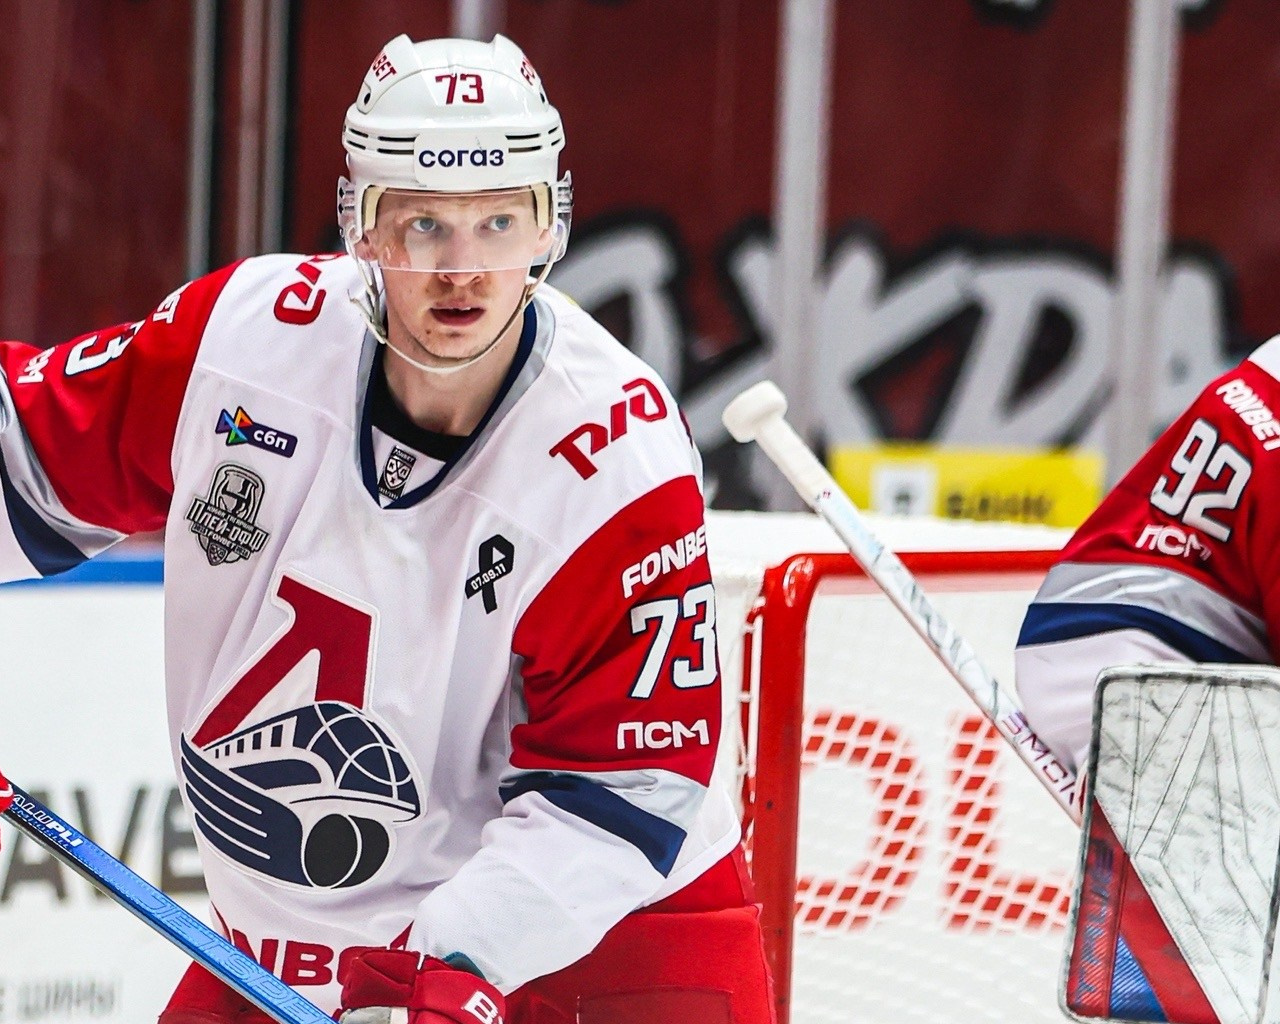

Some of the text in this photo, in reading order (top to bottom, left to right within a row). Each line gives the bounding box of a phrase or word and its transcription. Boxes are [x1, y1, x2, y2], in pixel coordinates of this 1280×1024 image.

[435, 73, 485, 105] 73
[418, 149, 504, 168] согаз
[17, 347, 56, 384] СМ
[65, 320, 146, 376] 3
[253, 430, 288, 450] сбп
[1150, 418, 1252, 543] 92
[1135, 523, 1212, 561] ПСМ
[470, 563, 507, 590] 07.09.11
[622, 524, 707, 598] FONBE
[630, 583, 718, 699] 73
[617, 719, 710, 750] ПСМ
